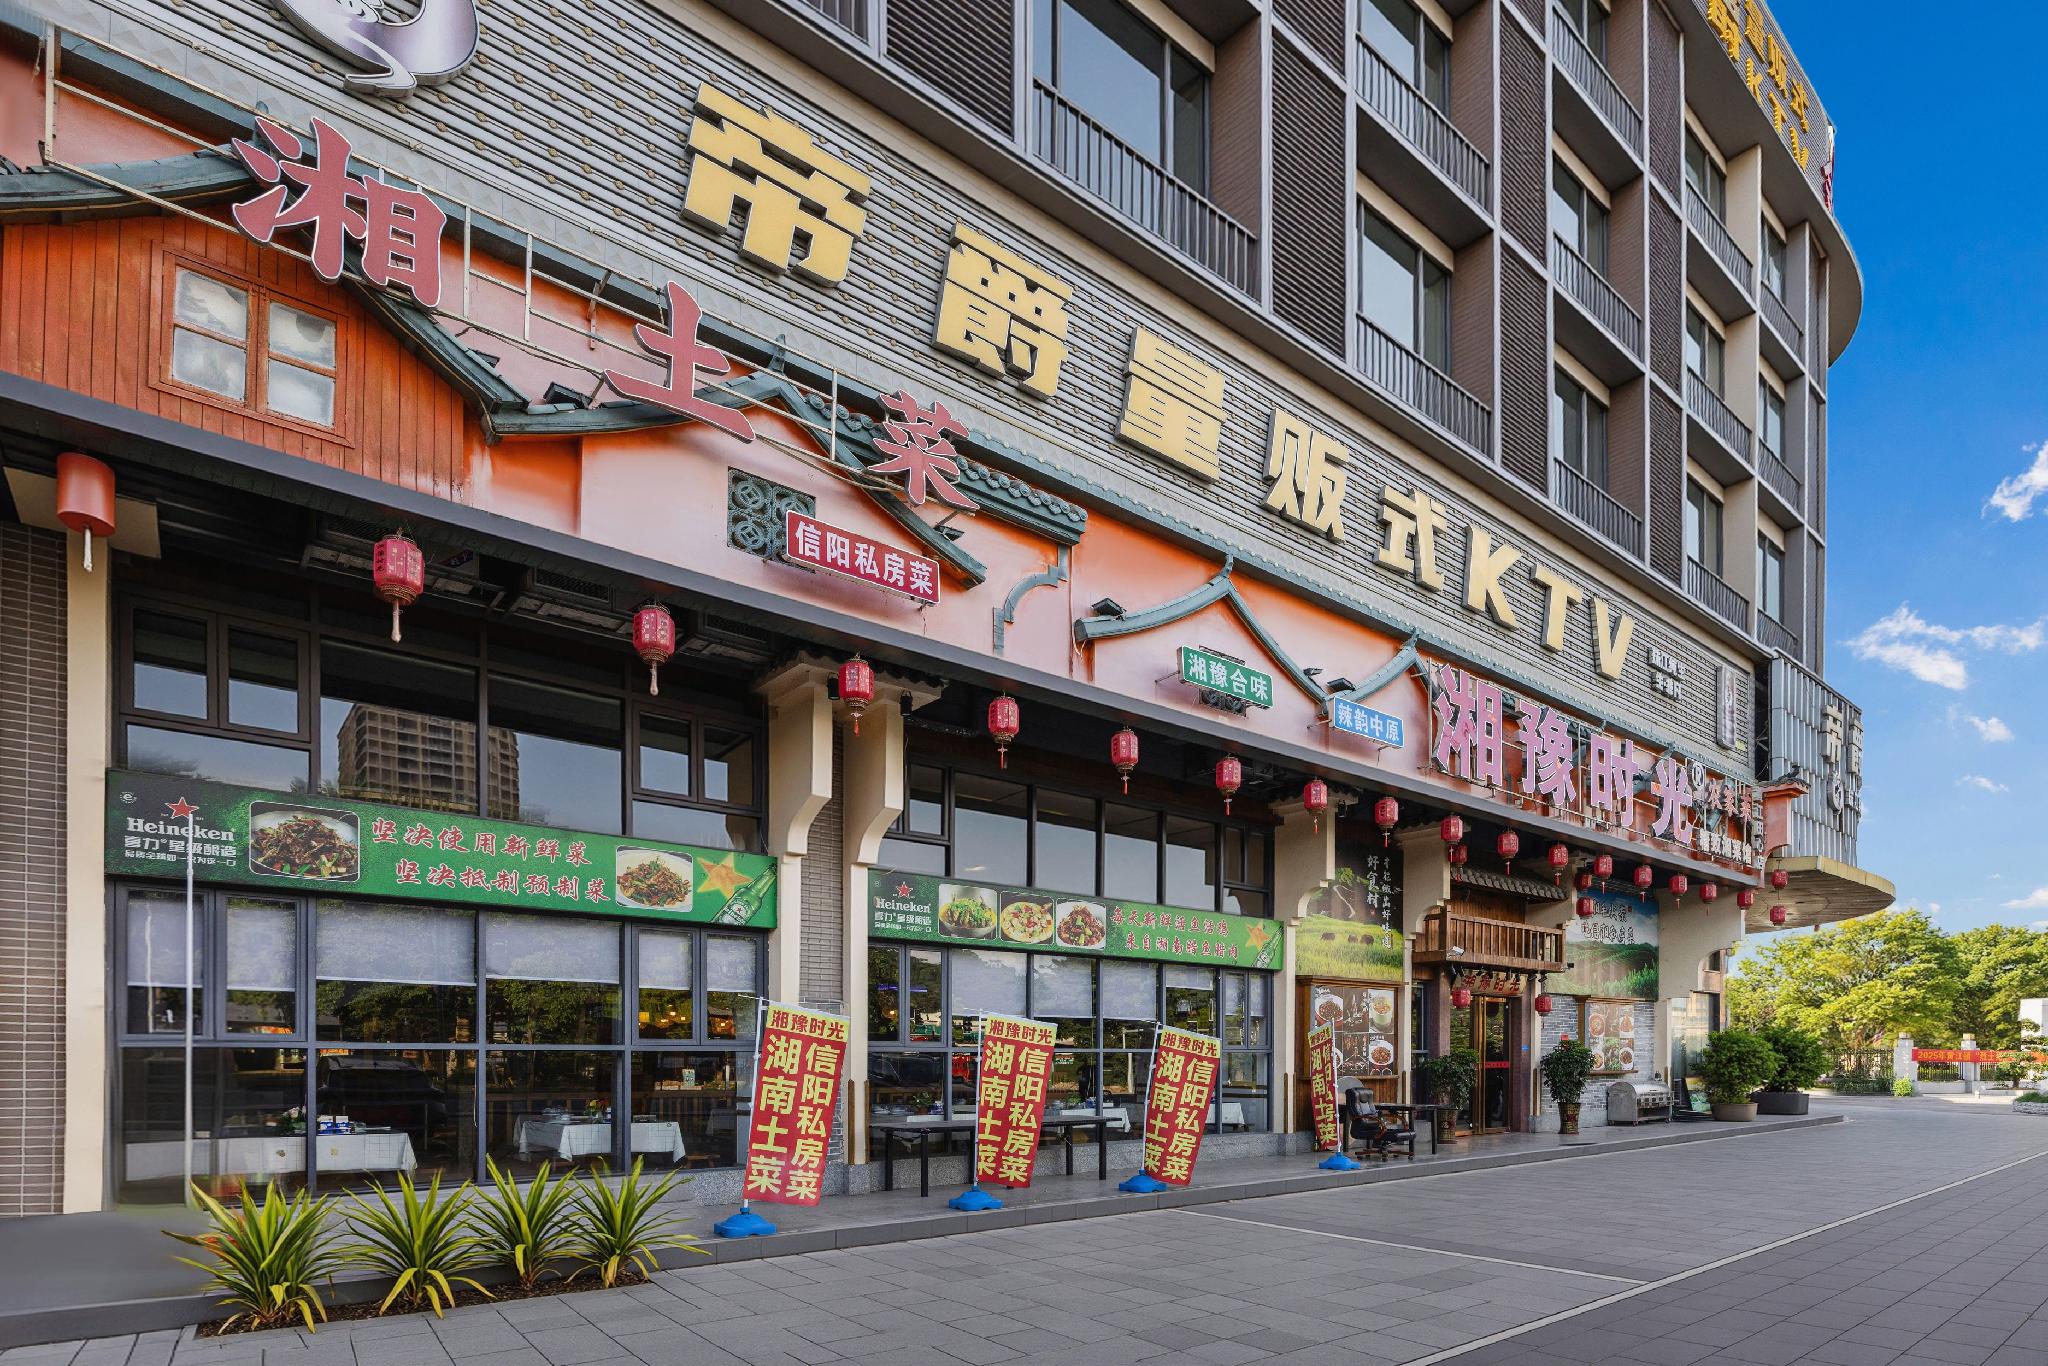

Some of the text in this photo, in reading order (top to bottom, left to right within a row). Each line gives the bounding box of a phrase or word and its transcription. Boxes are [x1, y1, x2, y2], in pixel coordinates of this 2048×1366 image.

[1746, 57, 1808, 172] KTV
[231, 115, 979, 512] 湘土菜
[795, 521, 933, 595] 信阳私房菜
[1187, 652, 1269, 701] 湘豫合味
[1338, 703, 1400, 742] 辣韵中原
[1433, 664, 1692, 844] 湘豫时光
[126, 817, 235, 842] Heineken
[371, 817, 592, 868] 坚决使用新鲜菜
[395, 858, 611, 904] 坚决抵制预制菜
[771, 1008, 845, 1041] 湘豫时光
[989, 1018, 1053, 1045] 湘豫时光
[1162, 1031, 1219, 1057] 湘豫时光
[747, 1033, 803, 1195] 湖南土菜
[785, 1042, 841, 1201] 信阳私房菜
[978, 1039, 1016, 1177] 湖南土菜
[998, 1046, 1050, 1183] 信阳私房菜
[1144, 1050, 1186, 1174] 湖南土菜
[1161, 1057, 1215, 1182] 信阳私房菜
